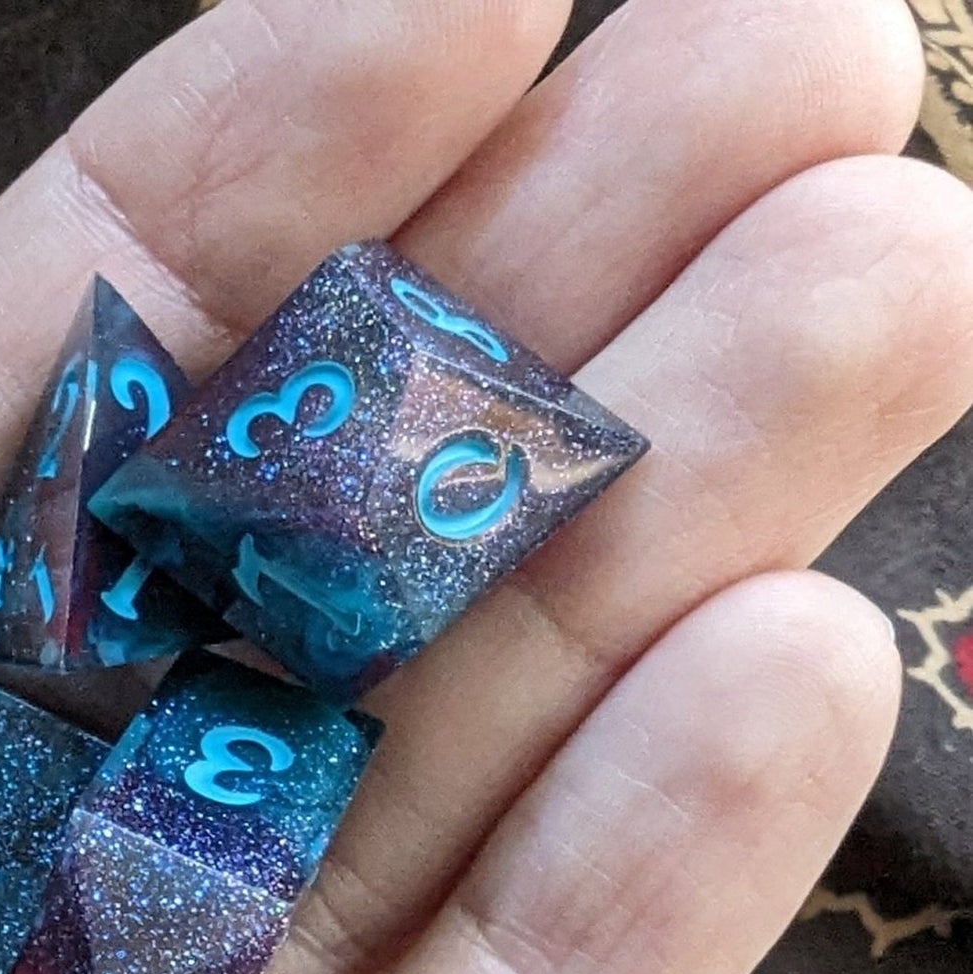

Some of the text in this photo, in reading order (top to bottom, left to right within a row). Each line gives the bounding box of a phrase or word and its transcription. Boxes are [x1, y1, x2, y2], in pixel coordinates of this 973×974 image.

[390, 279, 507, 362] 8
[226, 360, 355, 458] 3
[417, 436, 526, 542] 0
[185, 726, 294, 805] 3
